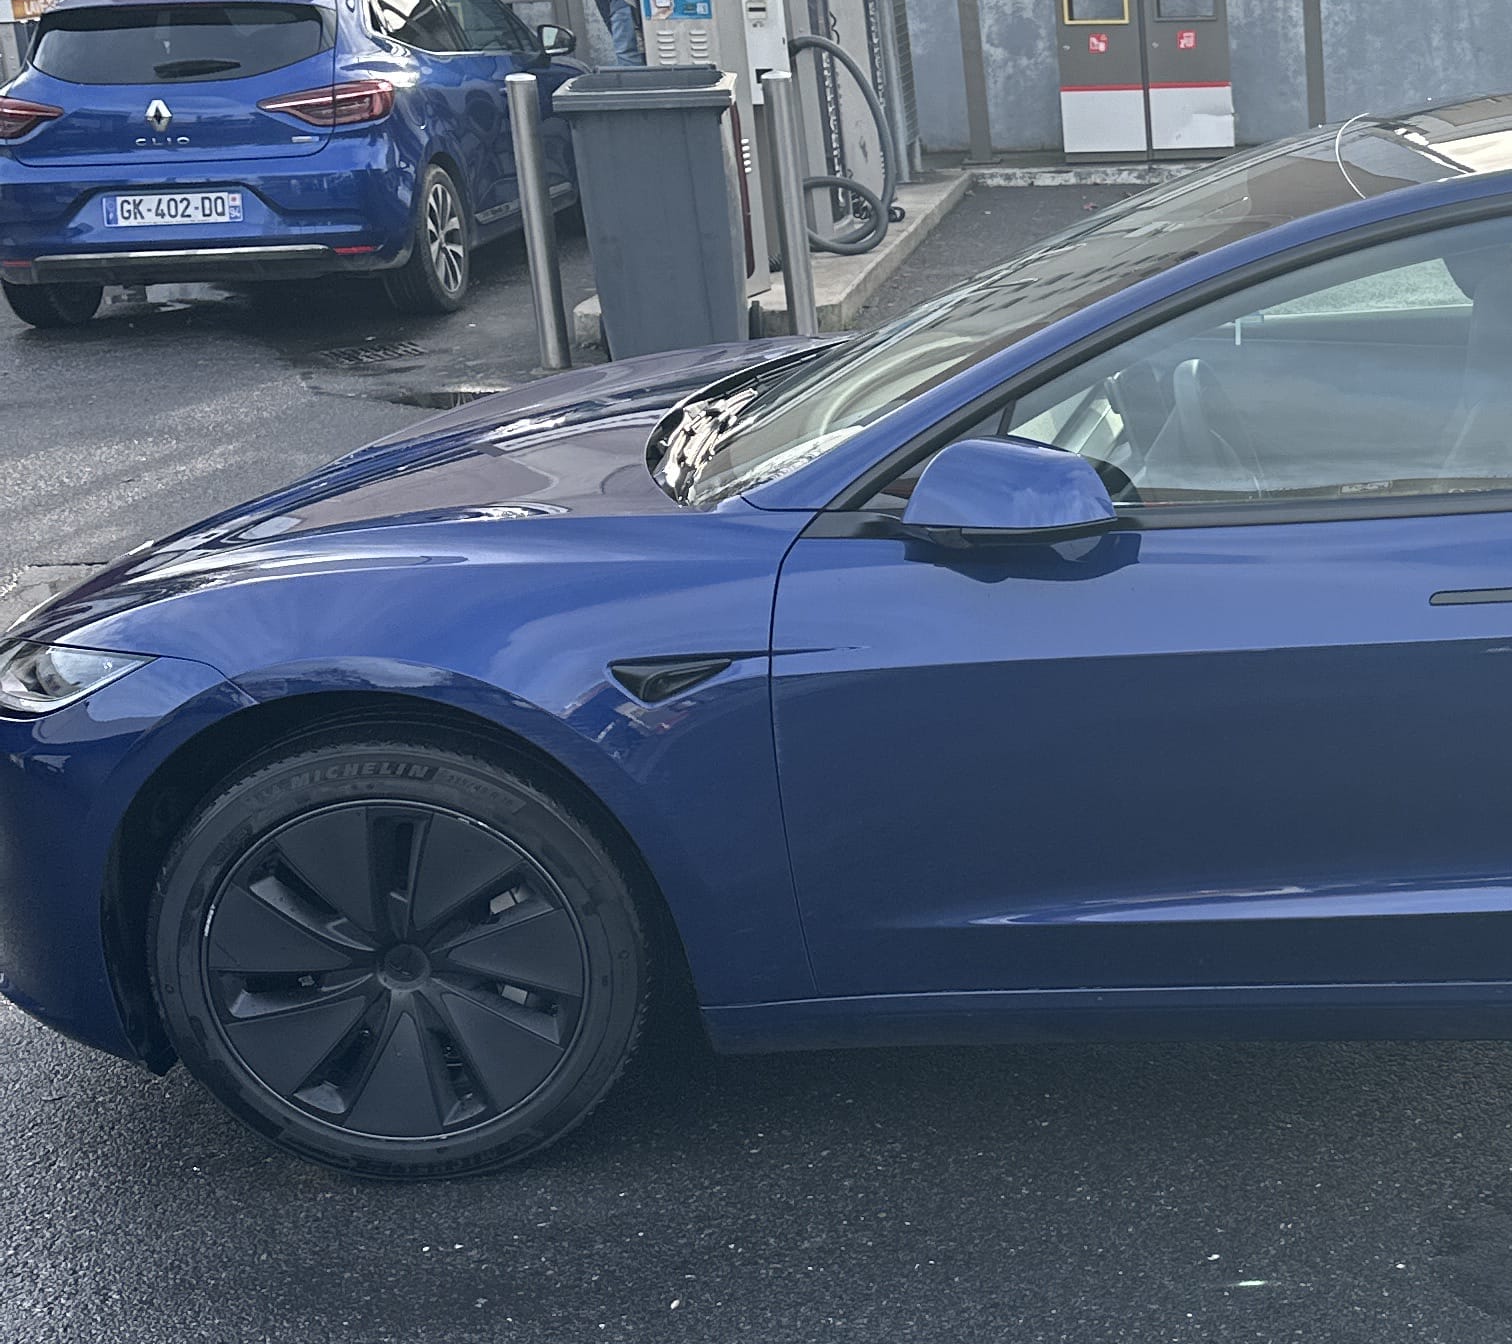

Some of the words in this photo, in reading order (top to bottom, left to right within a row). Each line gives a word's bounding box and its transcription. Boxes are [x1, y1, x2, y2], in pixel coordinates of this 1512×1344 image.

[136, 136, 190, 146] CLIO
[120, 195, 226, 221] GK-402-DQ
[291, 761, 430, 789] MICHELIN
